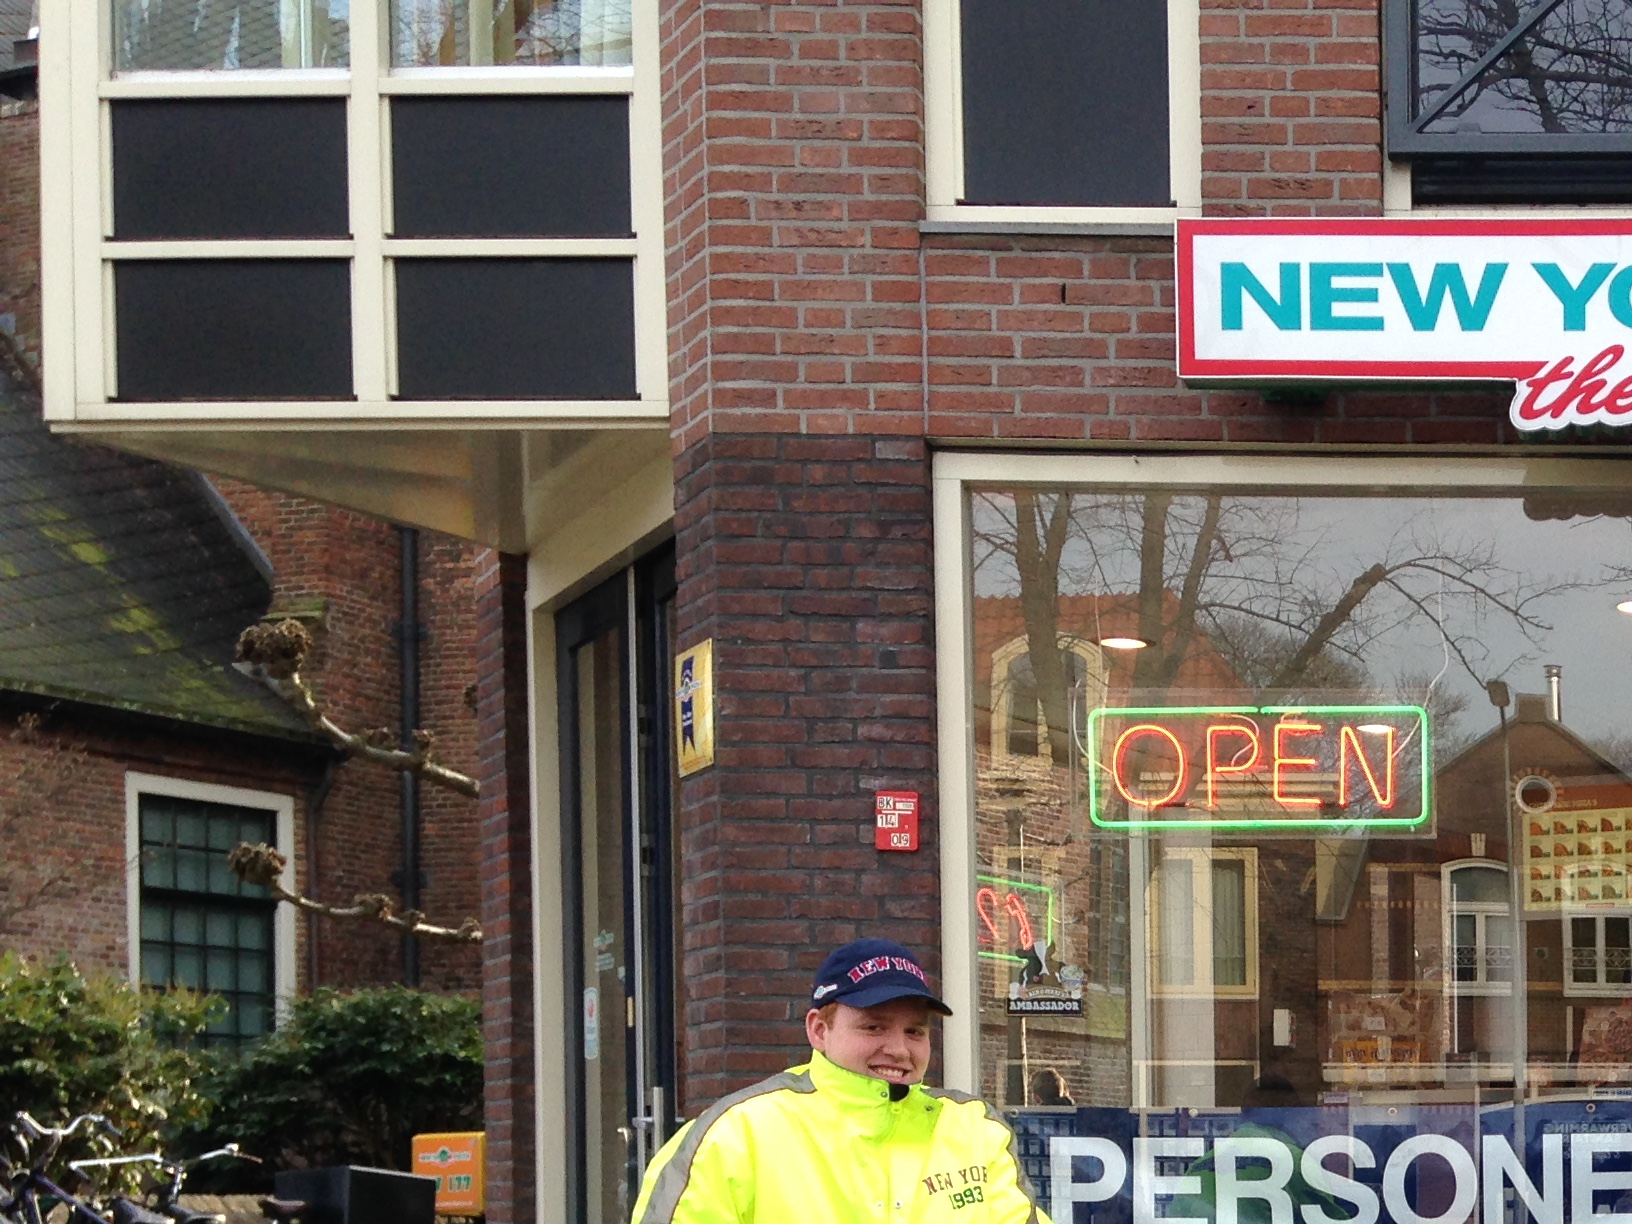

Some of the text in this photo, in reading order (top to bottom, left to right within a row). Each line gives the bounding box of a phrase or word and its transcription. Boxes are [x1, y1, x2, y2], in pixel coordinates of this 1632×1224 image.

[1221, 262, 1508, 332] NEW
[1111, 724, 1396, 808] OPEN
[1009, 1001, 1079, 1010] AMBASSADOR
[922, 1172, 954, 1195] NEW
[948, 1186, 984, 1210] 1993
